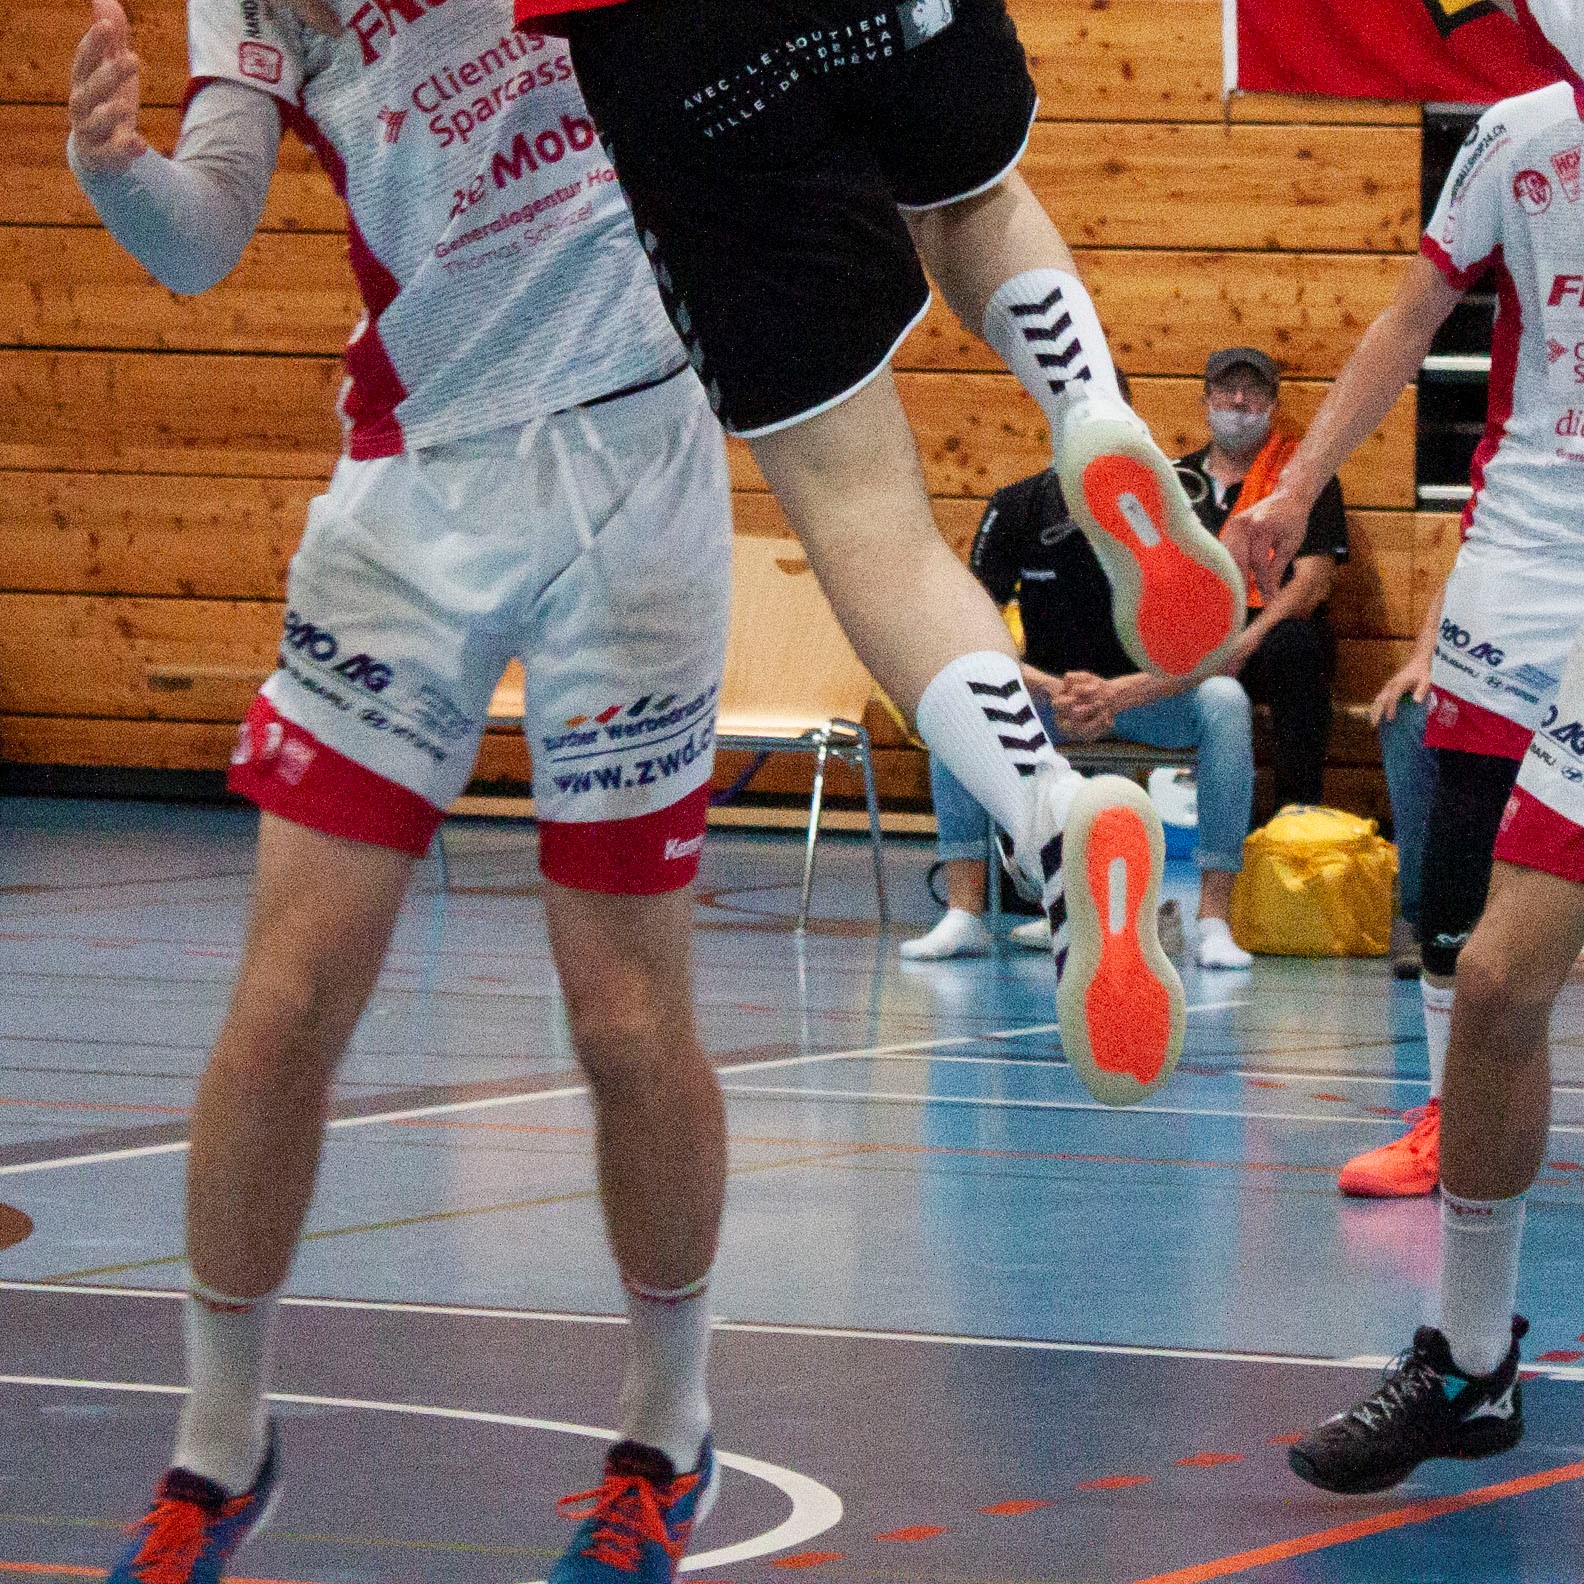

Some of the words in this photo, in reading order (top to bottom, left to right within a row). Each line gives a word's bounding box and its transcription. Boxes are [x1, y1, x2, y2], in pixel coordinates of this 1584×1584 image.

[411, 31, 547, 115] Clientis
[429, 55, 574, 149] Sparcass
[333, 652, 395, 694] AG
